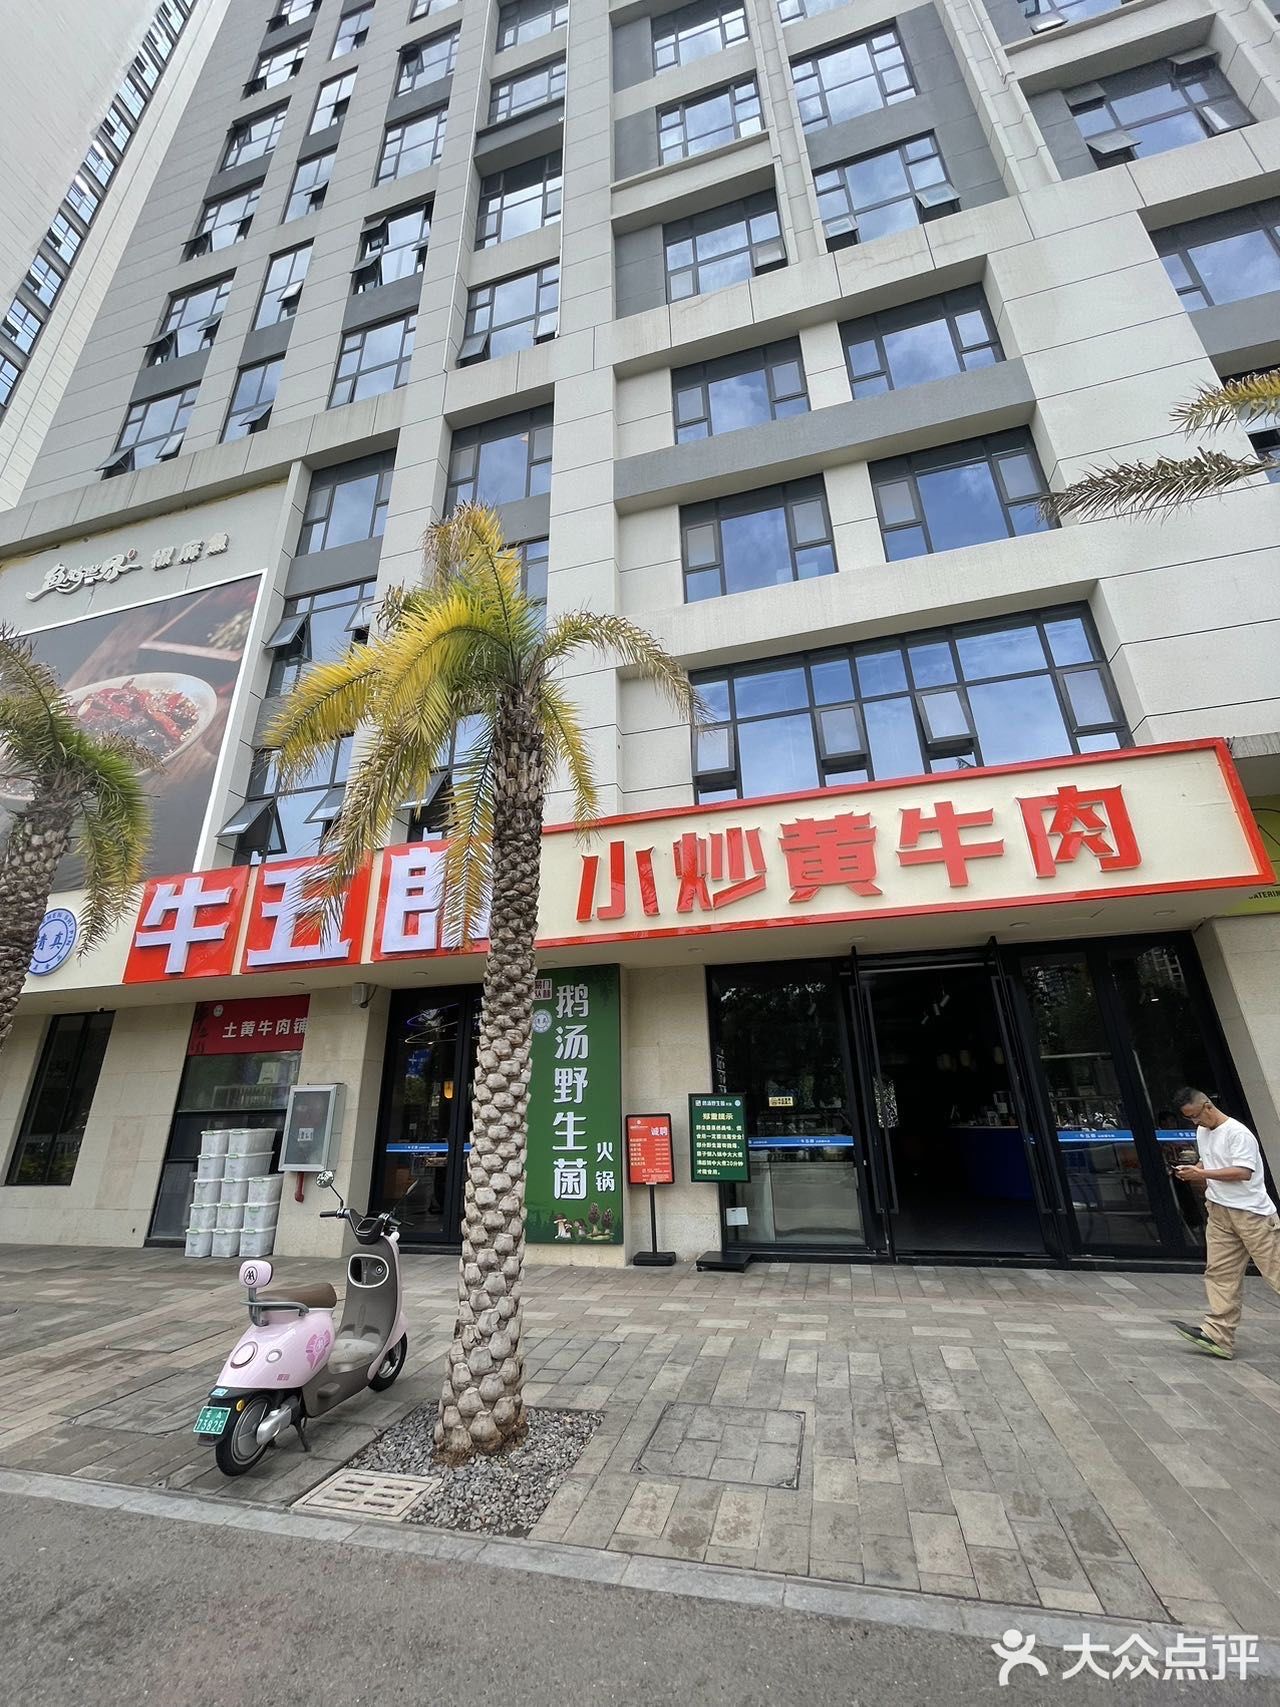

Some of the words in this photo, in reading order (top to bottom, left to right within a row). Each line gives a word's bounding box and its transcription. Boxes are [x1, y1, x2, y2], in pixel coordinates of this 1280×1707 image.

[576, 784, 1142, 923] 小炒黄牛肉
[553, 984, 590, 1200] 鹅汤野生菌
[595, 1141, 616, 1192] 火锅
